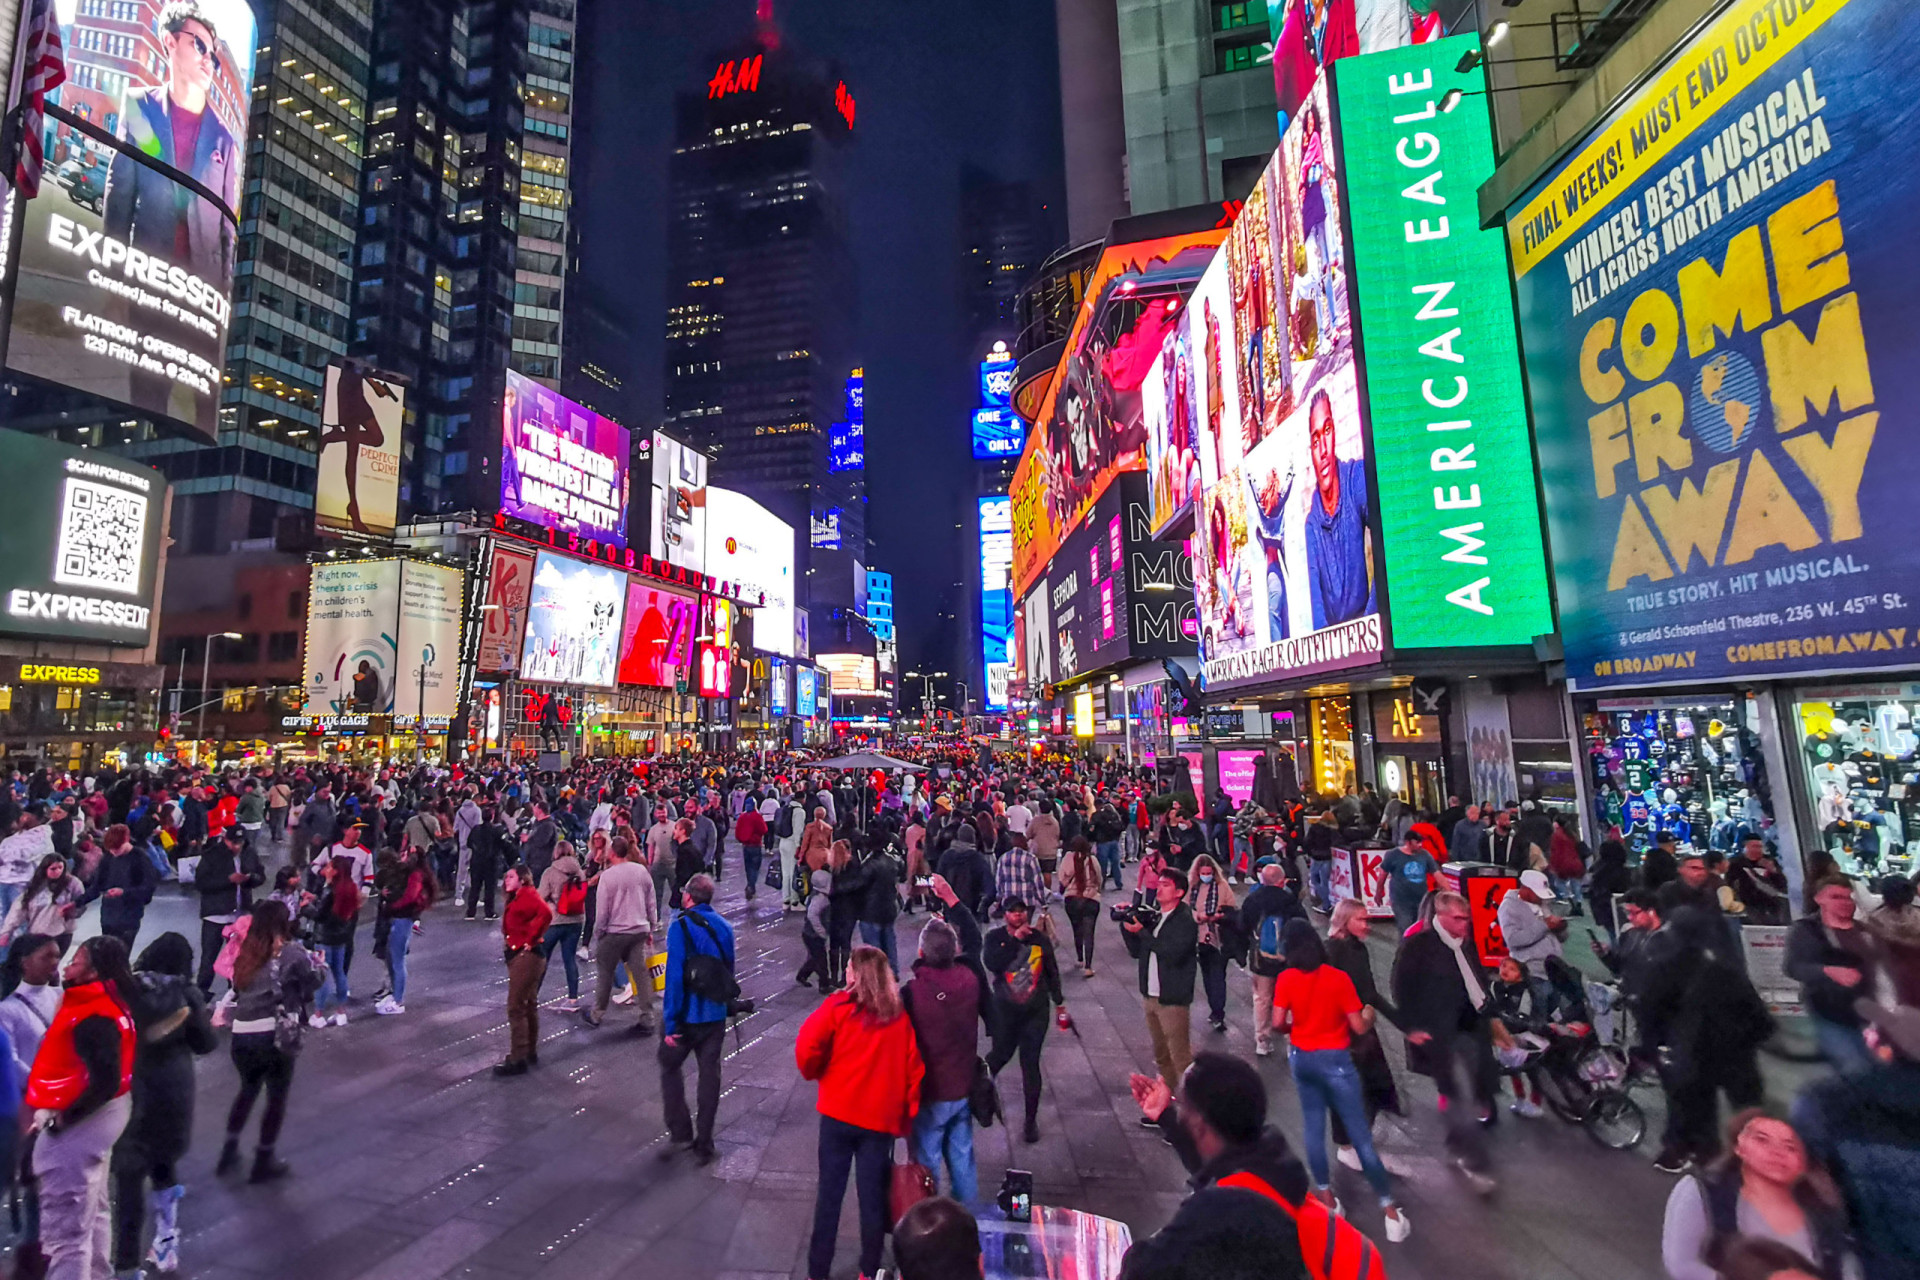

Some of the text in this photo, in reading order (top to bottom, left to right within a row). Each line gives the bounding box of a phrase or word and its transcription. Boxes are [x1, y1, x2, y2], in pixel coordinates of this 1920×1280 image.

[1388, 67, 1450, 244] EAGLE
[1521, 205, 1563, 255] FINAL
[1562, 138, 1625, 217] WEEKS!
[1629, 89, 1681, 160] MUST
[1685, 55, 1729, 109] END
[1564, 66, 1827, 286] WINNER! BEST MUSICAL
[1571, 114, 1832, 318] ALL ACROSS NORTH AMERICA
[88, 269, 139, 301] Curated
[162, 299, 181, 317] for
[1579, 178, 1851, 404] COME
[63, 305, 138, 346] FLATIRON
[84, 333, 109, 356] 129
[108, 342, 139, 367] Fifth
[138, 353, 166, 375] Ave.
[1587, 291, 1875, 499] FROM
[977, 411, 1001, 423] ONE
[1010, 418, 1020, 430] &
[360, 447, 398, 465] PERFECT
[639, 452, 650, 460] LG
[988, 438, 1020, 451] ONLY
[1411, 280, 1494, 616] AMERICAN
[67, 458, 100, 477] SCAN
[99, 465, 120, 481] FOR
[370, 460, 398, 476] CRIME
[611, 488, 619, 509] A
[1607, 410, 1880, 591] AWAY
[317, 571, 339, 581] Right
[624, 548, 742, 600] BROADWAY
[1627, 554, 1870, 613] TRUE STORY. HIT MUSICAL.
[315, 583, 346, 592] there's
[354, 582, 379, 591] crisis
[1053, 569, 1078, 611] SEPHORA
[314, 596, 366, 606] in children's
[314, 608, 374, 619] mental health.
[1628, 630, 1662, 645] Gerald
[1663, 618, 1726, 639] Schoenfeld
[1727, 610, 1784, 630] Theatre,
[1784, 605, 1814, 623] 236
[1816, 602, 1840, 617] W.
[1882, 593, 1907, 611] St.
[663, 600, 699, 667] 21
[1205, 617, 1380, 684] AMERICAN EAGLE OUTFITTERS
[20, 664, 100, 683] EXPRESS
[1594, 650, 1697, 677] ON BROADWAY
[282, 716, 312, 726] GIFTS
[394, 714, 416, 725] GIFTS
[1621, 719, 1630, 733] 8
[1624, 749, 1640, 760] 17
[1629, 771, 1641, 787] 2
[1630, 808, 1648, 819] 33
